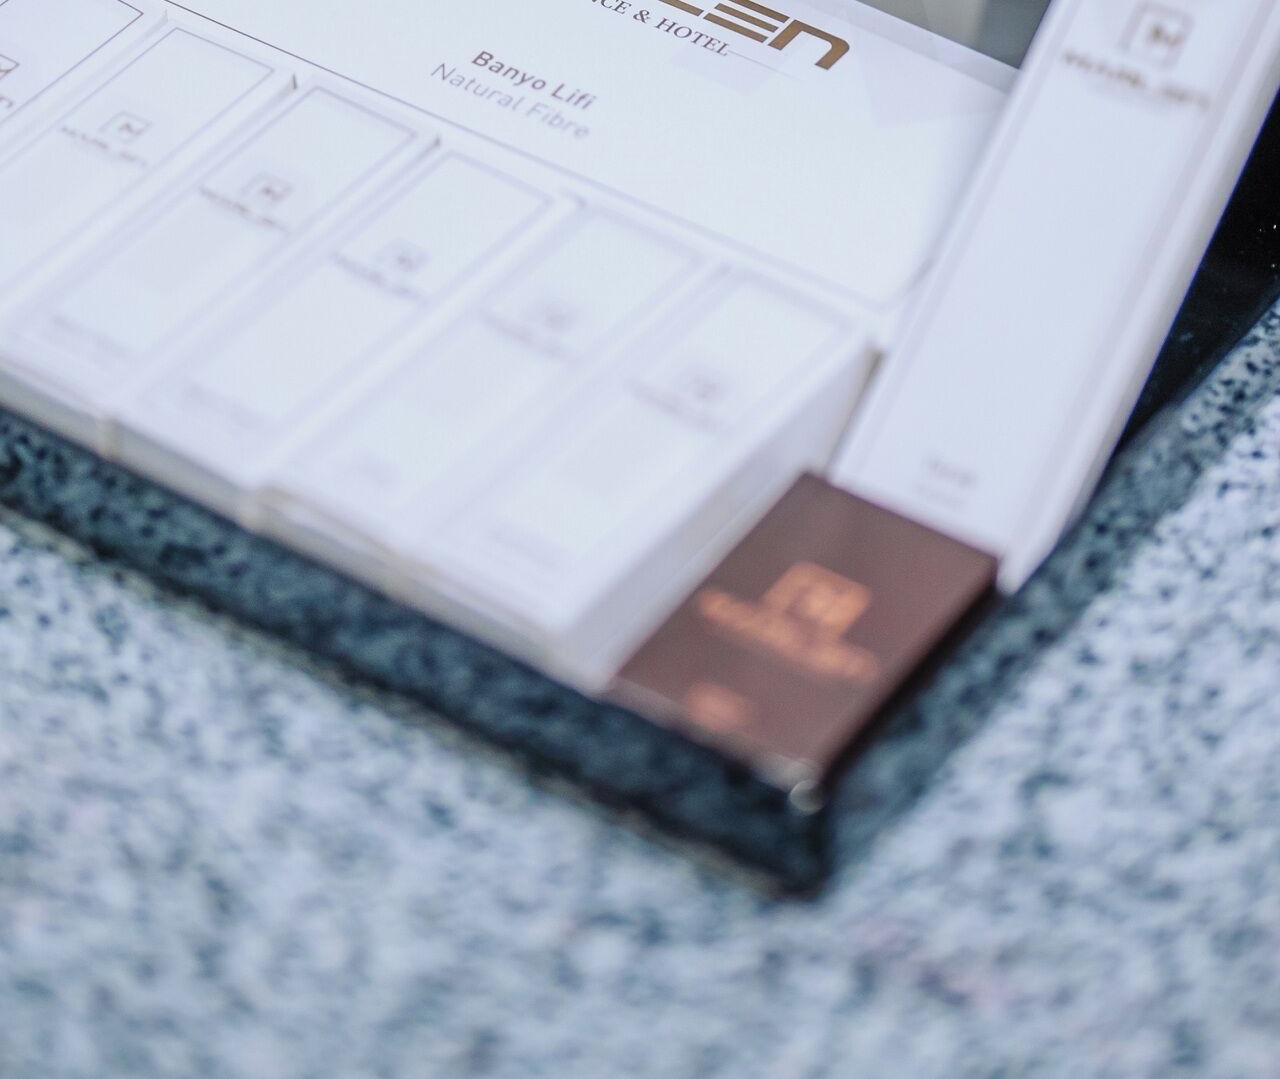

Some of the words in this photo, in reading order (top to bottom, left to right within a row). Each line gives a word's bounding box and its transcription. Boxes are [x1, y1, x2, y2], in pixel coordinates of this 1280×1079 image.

[633, 7, 651, 25] &
[655, 16, 730, 57] HOTEL
[431, 62, 523, 113] Natural
[528, 101, 591, 139] Fibre
[472, 50, 549, 92] Banyo
[551, 81, 598, 111] Lifi
